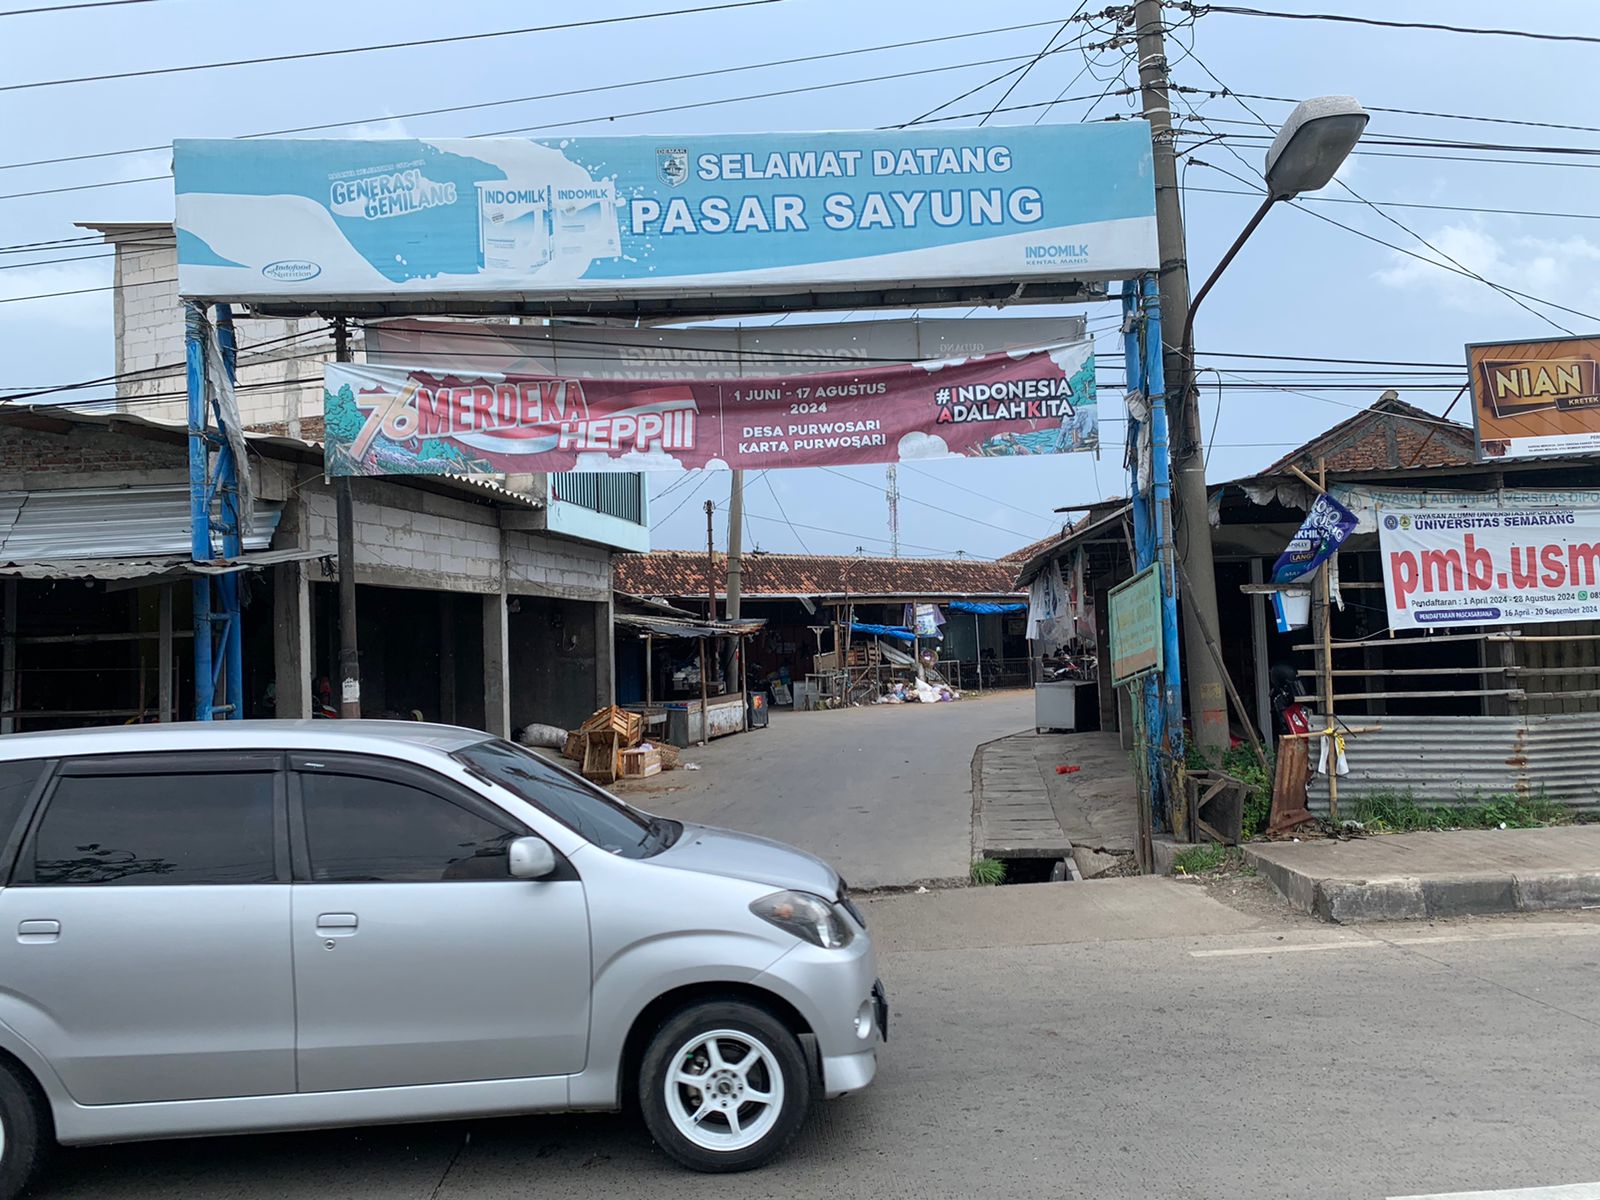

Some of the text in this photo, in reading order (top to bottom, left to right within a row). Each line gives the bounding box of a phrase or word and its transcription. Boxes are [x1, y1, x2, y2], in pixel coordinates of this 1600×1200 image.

[697, 146, 1013, 182] SELAMAT DATANG
[332, 169, 421, 205] GENERASI
[557, 188, 608, 200] INDOMILK
[364, 183, 457, 219] GEMILANG
[485, 189, 546, 204] INDOMILK
[631, 187, 1044, 235] PASAR SAYUNG
[1025, 244, 1089, 258] INDOMILK
[1496, 364, 1583, 398] NIAN
[734, 390, 741, 401] 1
[745, 389, 781, 401] JUNI
[796, 388, 811, 399] 17
[815, 383, 887, 398] AGUSTUS
[936, 378, 1073, 405] #INDONESIA
[416, 379, 589, 438] MERDEKA
[790, 402, 828, 414] 2024
[1568, 397, 1599, 406] KRETEK
[743, 419, 881, 439] DESA PURWOSARI
[739, 434, 887, 453] KARTA PURWOSARI
[1483, 492, 1566, 503] UNVERSITAS
[1415, 514, 1575, 530] UNIVERSITAS SEMARANG
[1390, 533, 1600, 610] pmb.usm
[1412, 598, 1457, 607] Pendaftaran
[1470, 597, 1488, 606] April
[1490, 595, 1507, 604] 2024
[1525, 594, 1556, 604] Agustus
[1557, 593, 1576, 601] 2024
[1504, 609, 1513, 617] 16
[1514, 609, 1530, 618] April
[1535, 608, 1543, 616] 20
[1545, 607, 1580, 617] September
[1581, 605, 1598, 613] 2024
